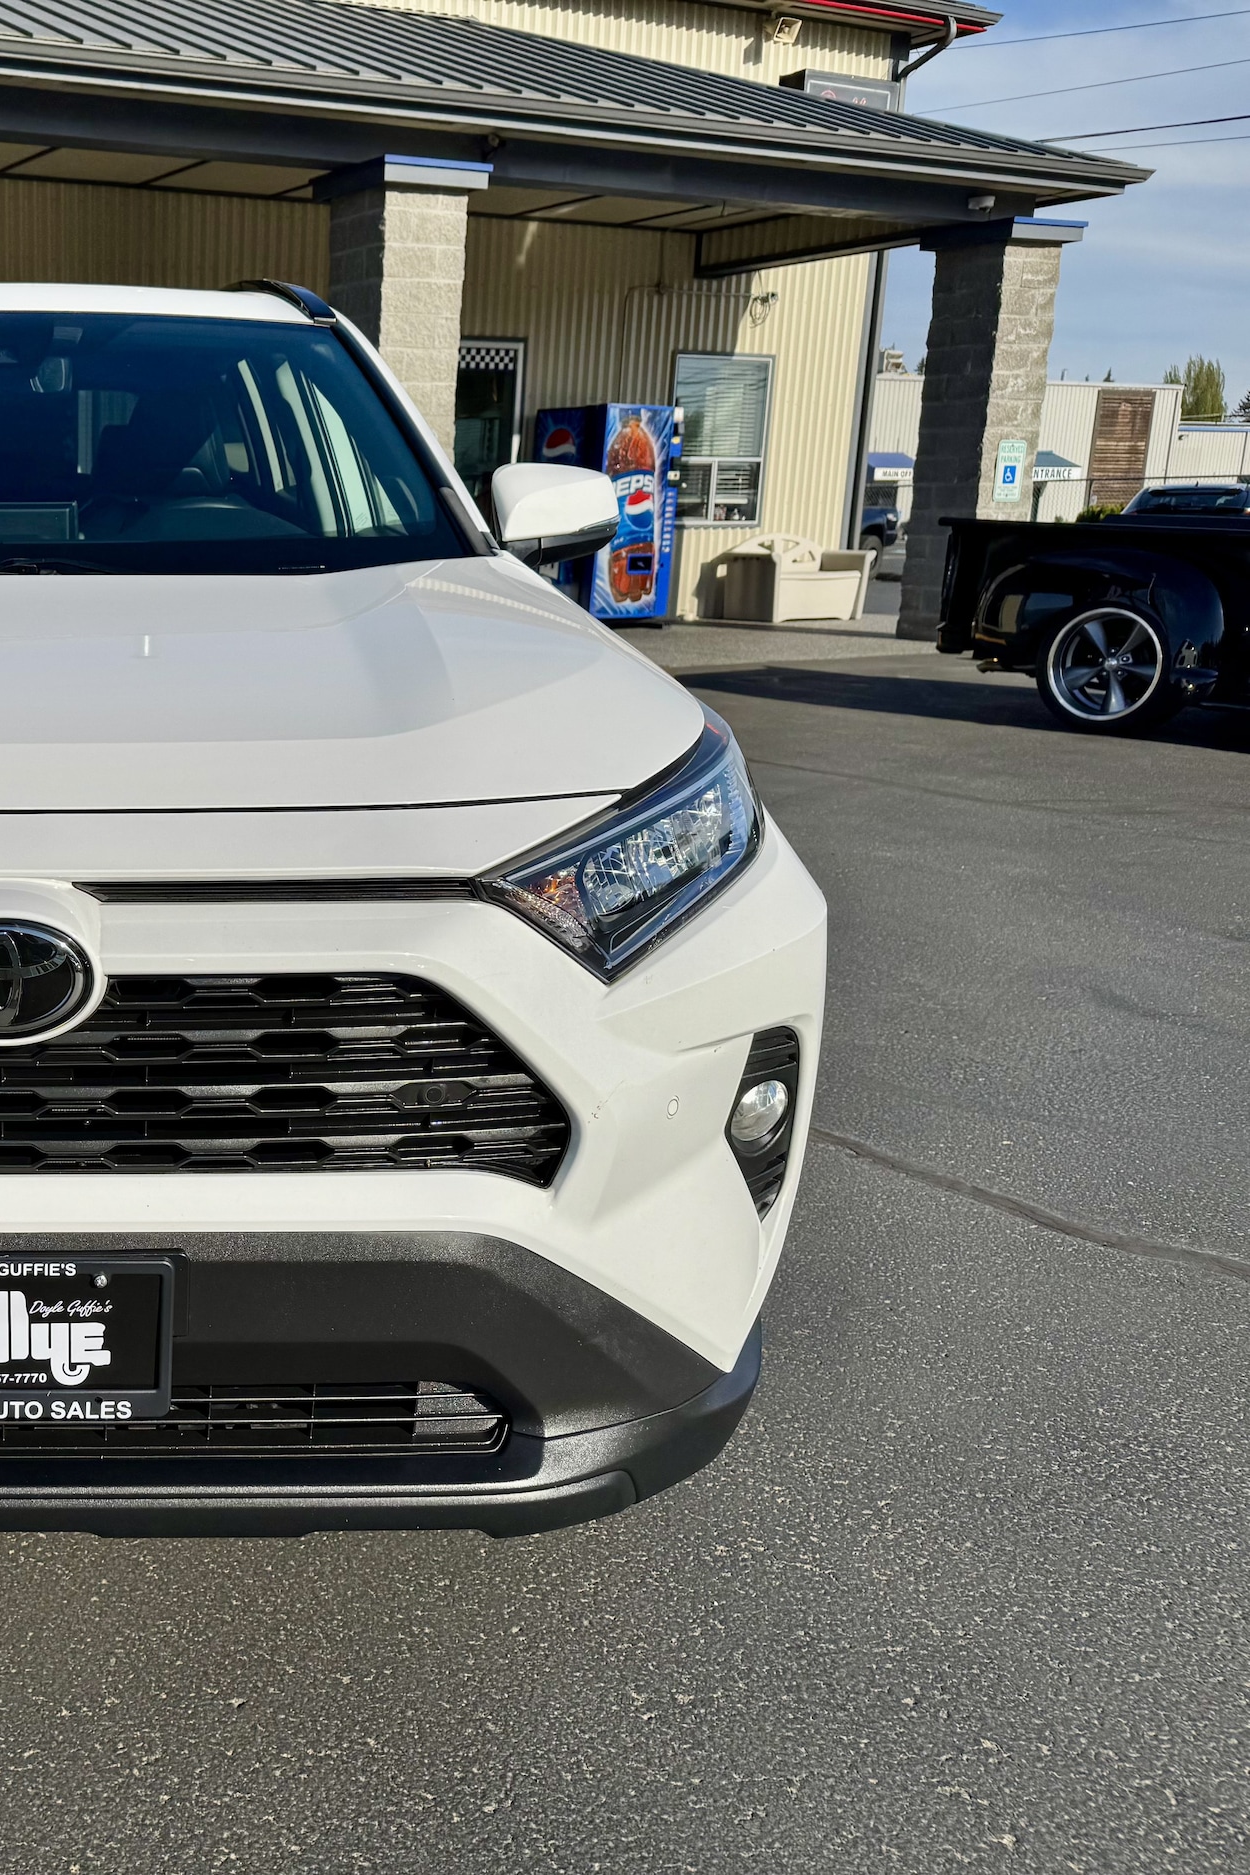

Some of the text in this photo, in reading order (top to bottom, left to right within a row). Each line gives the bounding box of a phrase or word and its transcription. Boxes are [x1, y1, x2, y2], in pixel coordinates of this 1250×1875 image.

[1033, 468, 1073, 479] NTRANCE
[29, 1300, 113, 1318] Doyle Guffie's
[50, 1400, 133, 1420] SALES
